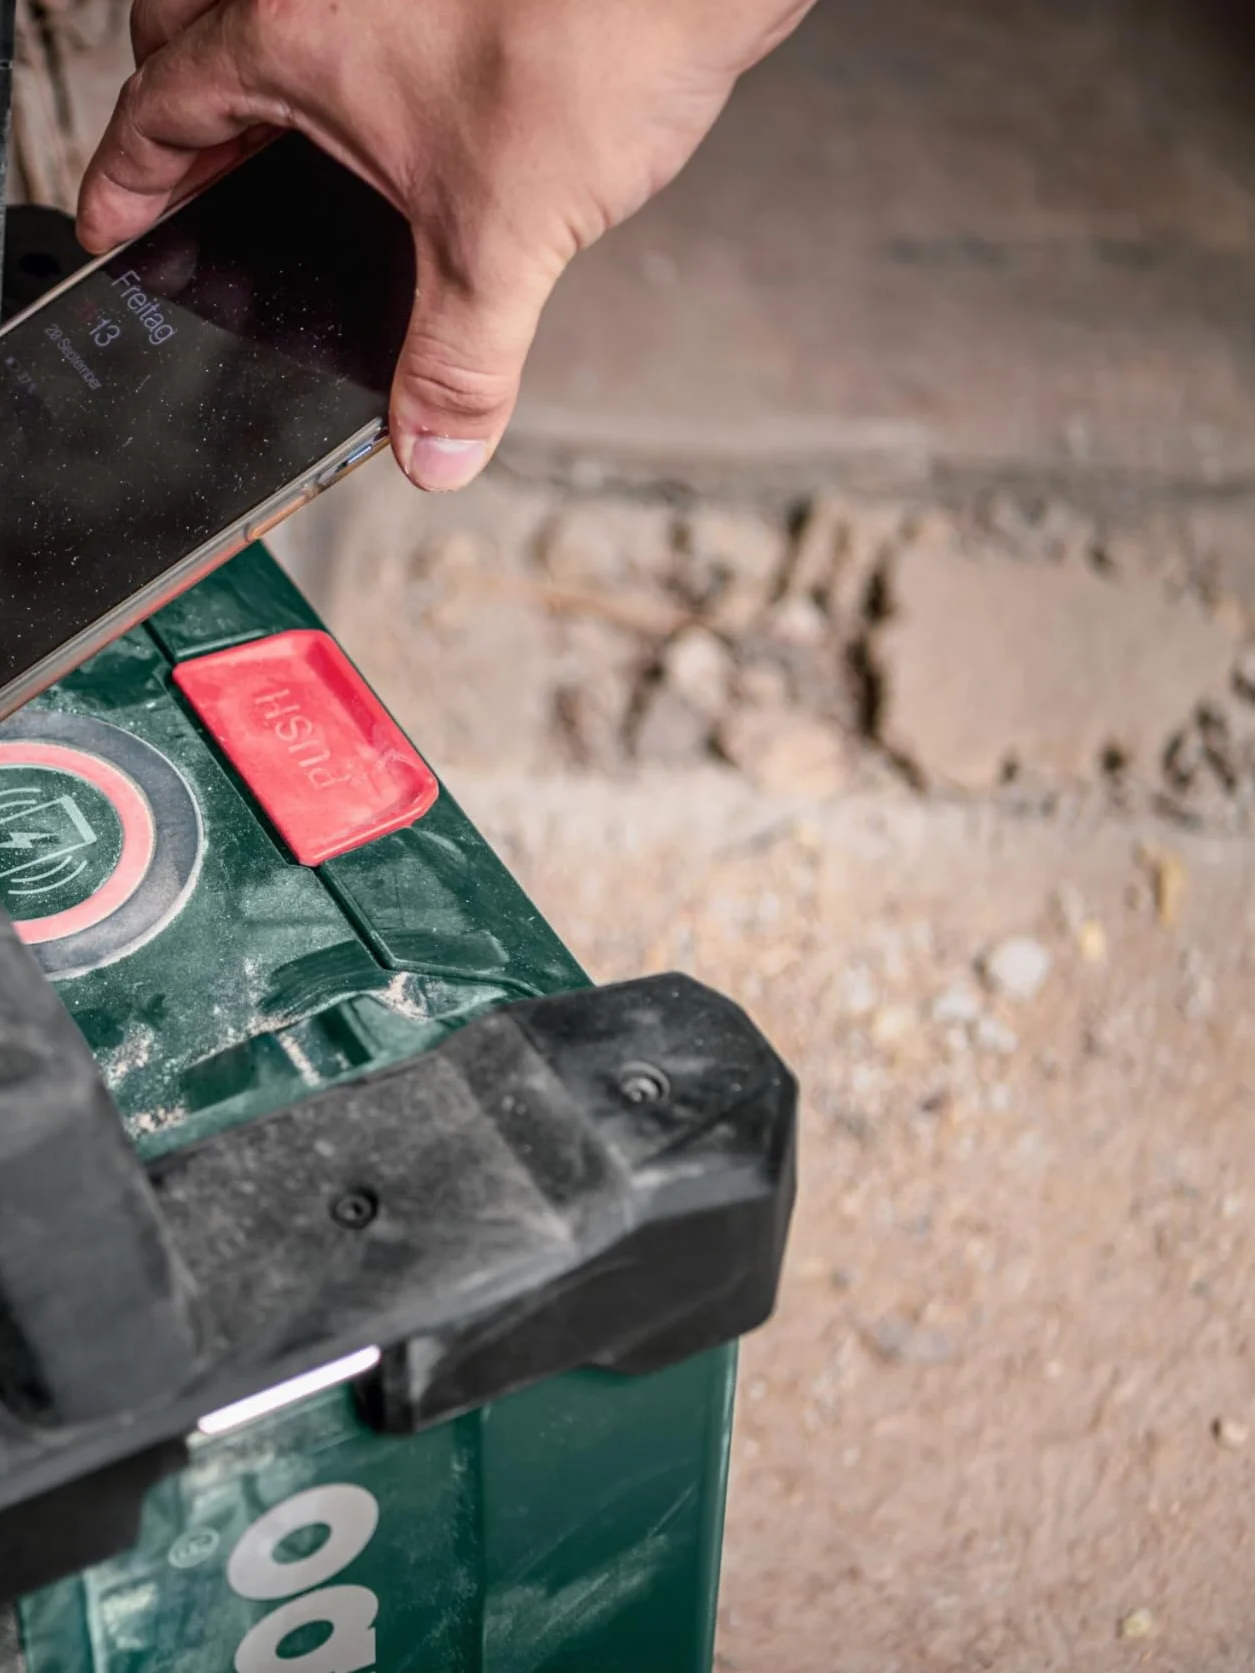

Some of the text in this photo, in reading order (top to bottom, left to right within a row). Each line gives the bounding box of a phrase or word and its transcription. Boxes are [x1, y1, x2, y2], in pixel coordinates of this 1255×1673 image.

[89, 318, 121, 348] 13
[110, 269, 178, 346] Freitag
[57, 337, 103, 391] September
[254, 688, 350, 790] PUSH
